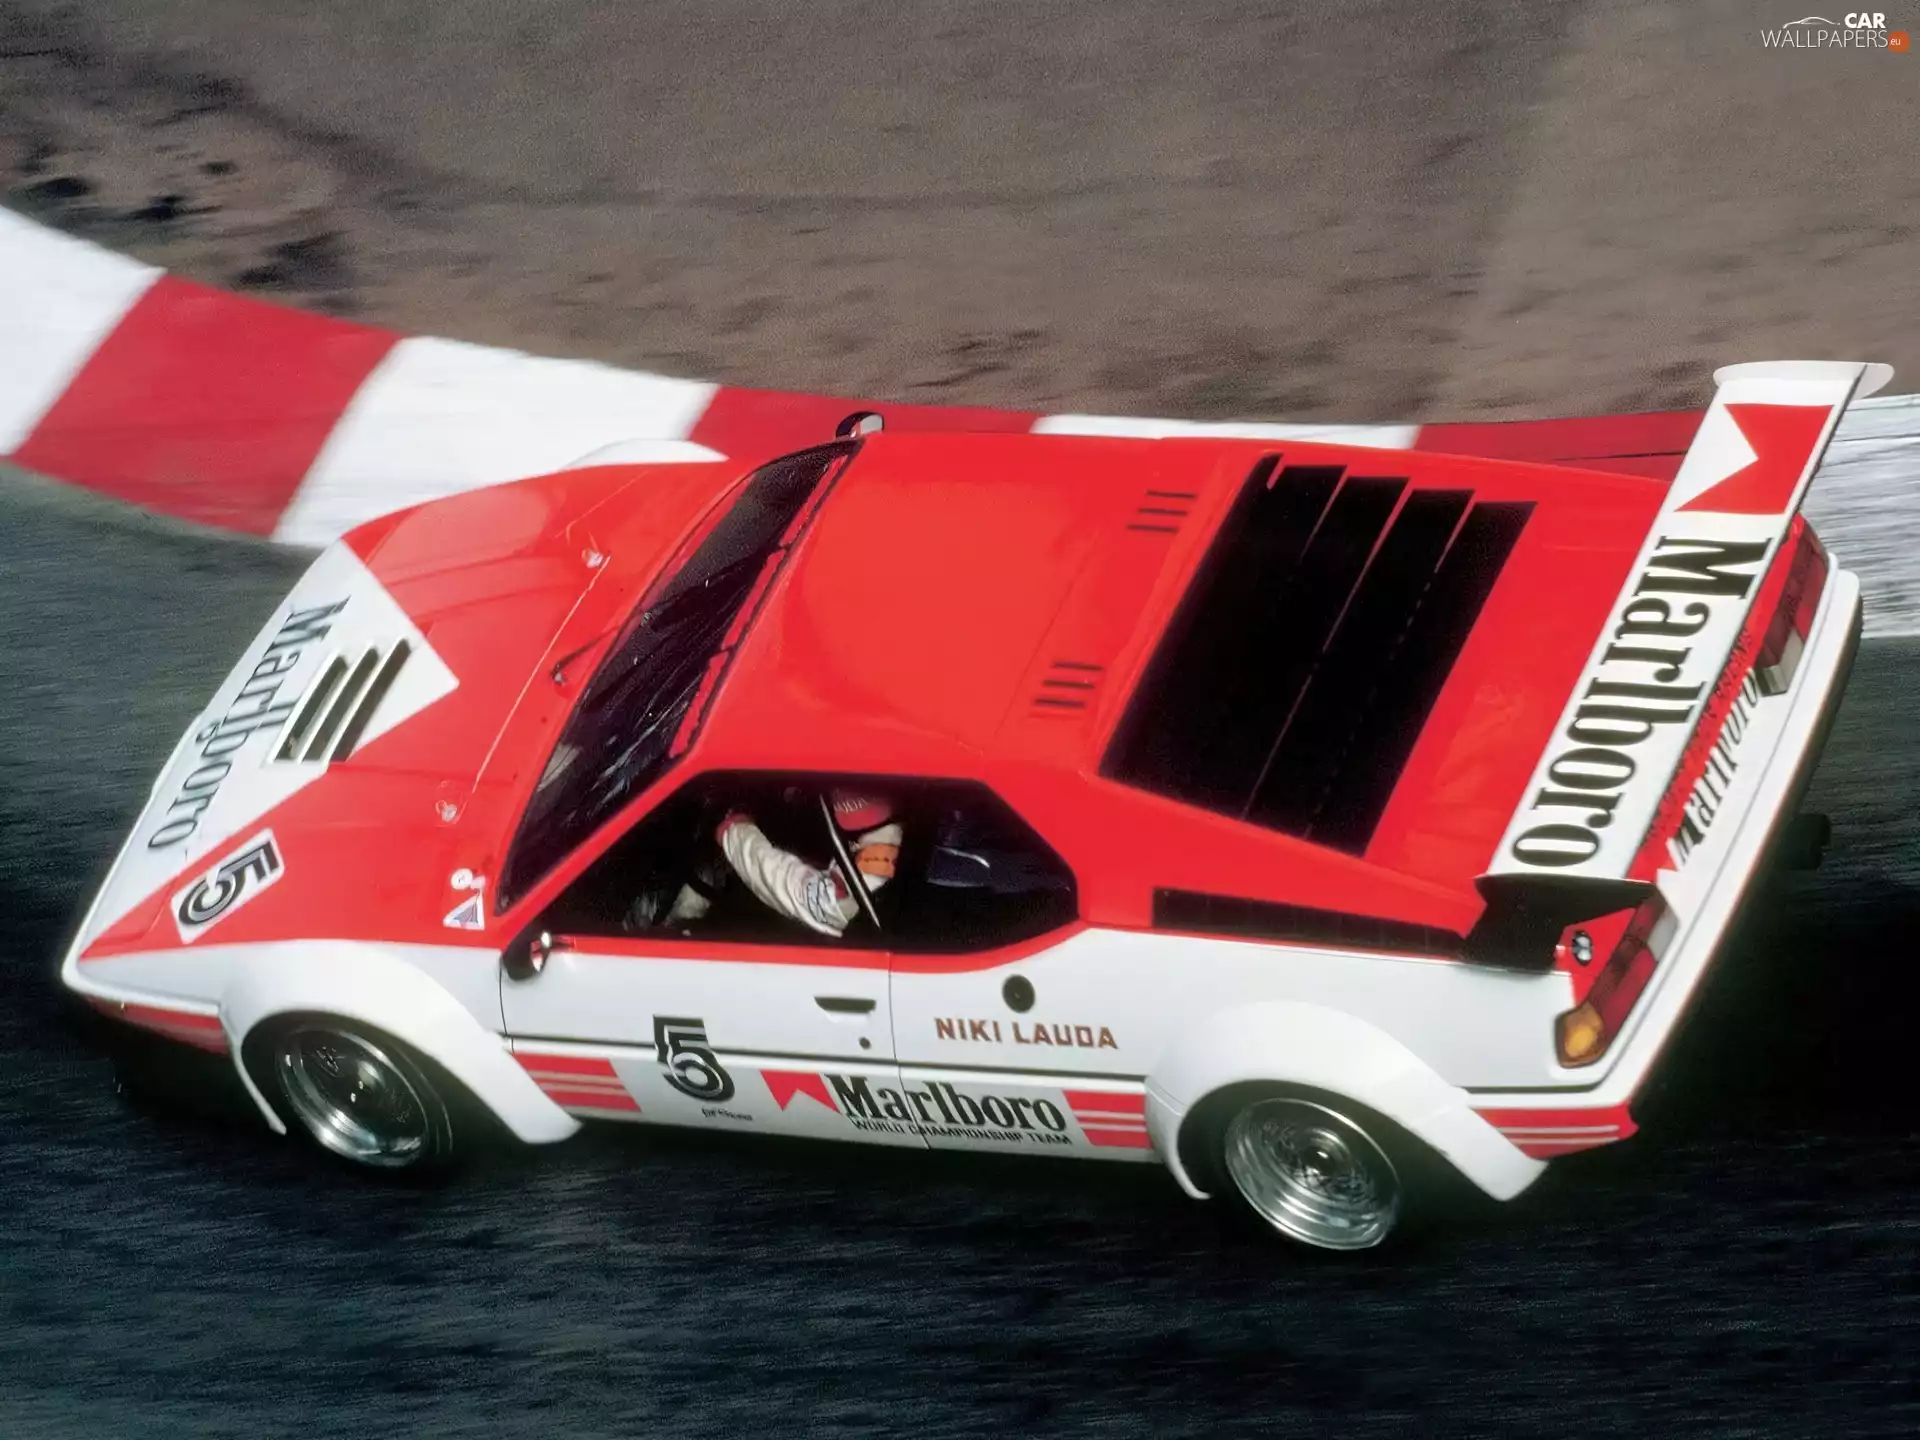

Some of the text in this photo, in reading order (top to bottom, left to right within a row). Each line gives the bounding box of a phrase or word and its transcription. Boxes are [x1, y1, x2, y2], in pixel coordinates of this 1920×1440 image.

[148, 594, 351, 850] Marlboro
[1512, 535, 1775, 868] Marlboro
[179, 841, 280, 925] 5
[653, 1014, 735, 1102] 5
[934, 1017, 1119, 1050] NIKI LAUDA
[824, 1073, 1067, 1132] Marlboro
[850, 1116, 905, 1135] WORLD
[1028, 1131, 1073, 1145] TEAM
